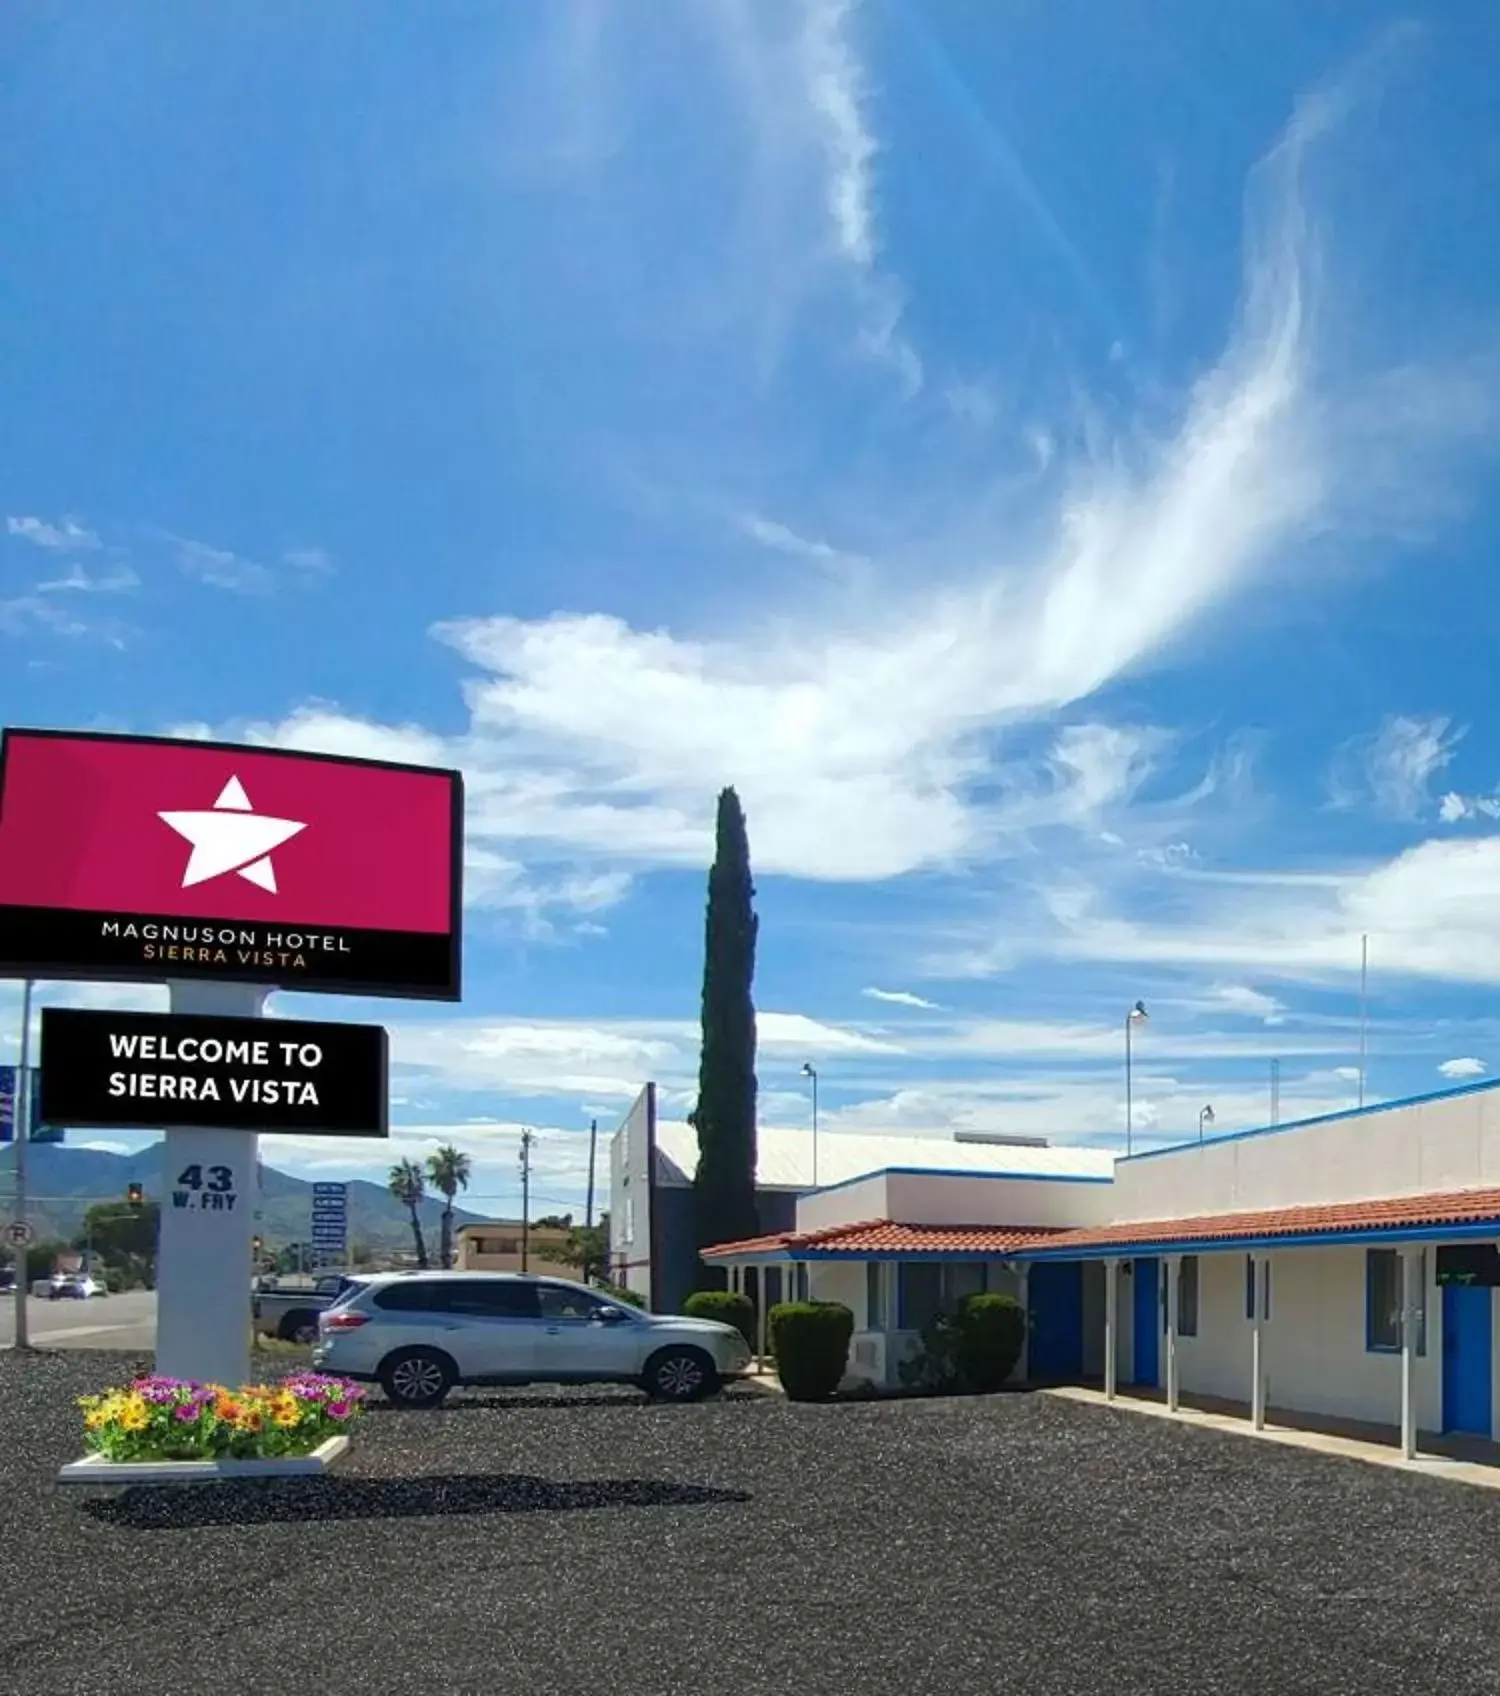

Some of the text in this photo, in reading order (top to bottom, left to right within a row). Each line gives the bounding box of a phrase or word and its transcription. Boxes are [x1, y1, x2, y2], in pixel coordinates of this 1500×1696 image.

[101, 921, 351, 952] MAGNUSON HOTEL
[143, 944, 308, 968] SIERRA VISTA
[109, 1033, 323, 1068] WELCOME TO
[108, 1071, 320, 1106] SIERRA VISTA
[177, 1164, 233, 1193] 43
[172, 1191, 239, 1212] W. FRY
